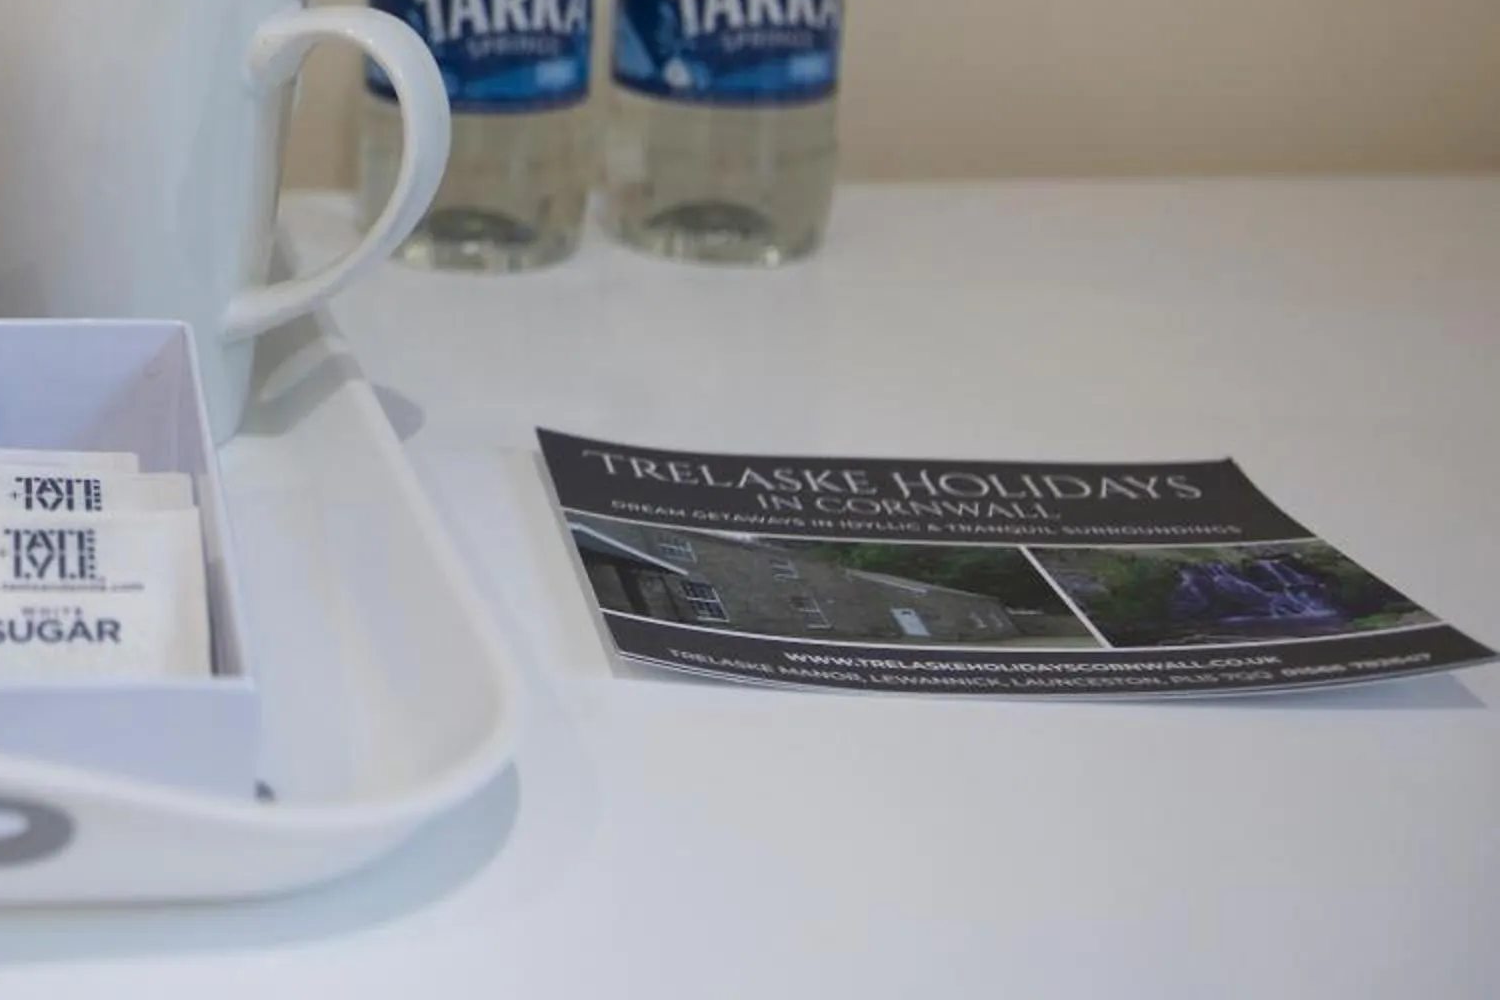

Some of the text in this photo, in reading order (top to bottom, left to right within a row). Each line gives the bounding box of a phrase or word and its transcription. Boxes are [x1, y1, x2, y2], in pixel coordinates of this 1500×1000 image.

[582, 448, 1203, 500] TRELASKE HOLIDAYS
[611, 499, 687, 519] DREAM
[690, 508, 807, 528] GETAWAYS
[755, 492, 1060, 520] IN CORNWALL
[3, 528, 97, 553] TATE
[10, 552, 98, 581] LYLE
[668, 648, 775, 674] TRELASKE
